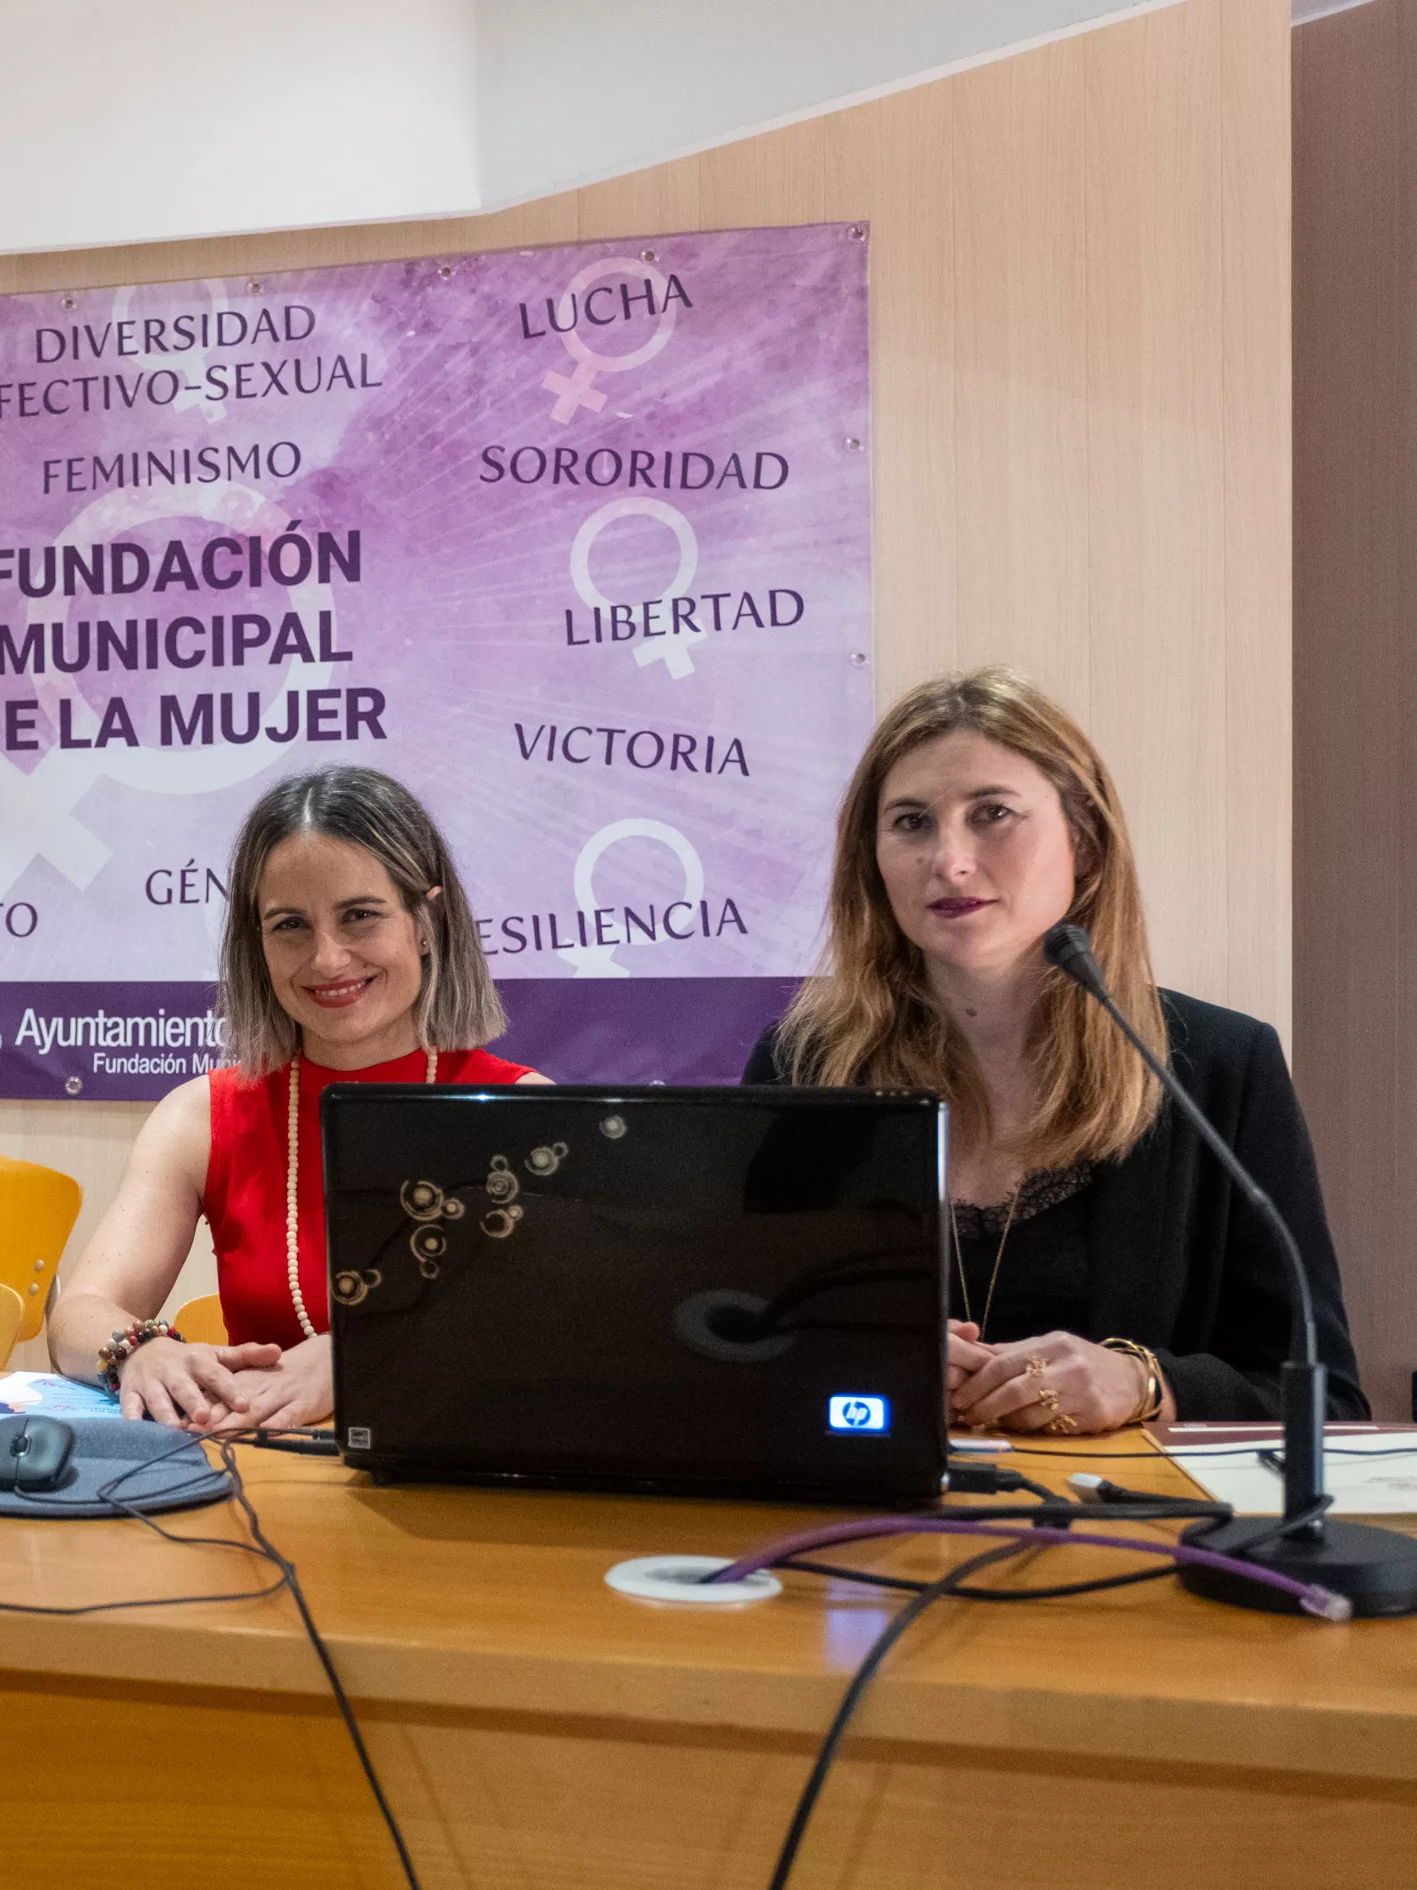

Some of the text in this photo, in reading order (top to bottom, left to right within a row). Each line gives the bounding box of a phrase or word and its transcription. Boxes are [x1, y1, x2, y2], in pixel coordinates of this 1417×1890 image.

[518, 273, 694, 340] LUCHA
[35, 304, 316, 364] DIVERSIDAD
[43, 441, 301, 495] FEMINISMO
[479, 445, 789, 490] SORORIDAD
[565, 589, 805, 646] LIBERTAD
[59, 696, 140, 749] LA
[160, 687, 388, 746] MUJER
[514, 723, 750, 777] VICTORIA
[145, 858, 231, 905] GÉN
[474, 898, 749, 956] ESILIENCIA
[93, 1052, 187, 1074] Fundación
[843, 1401, 870, 1426] hp
